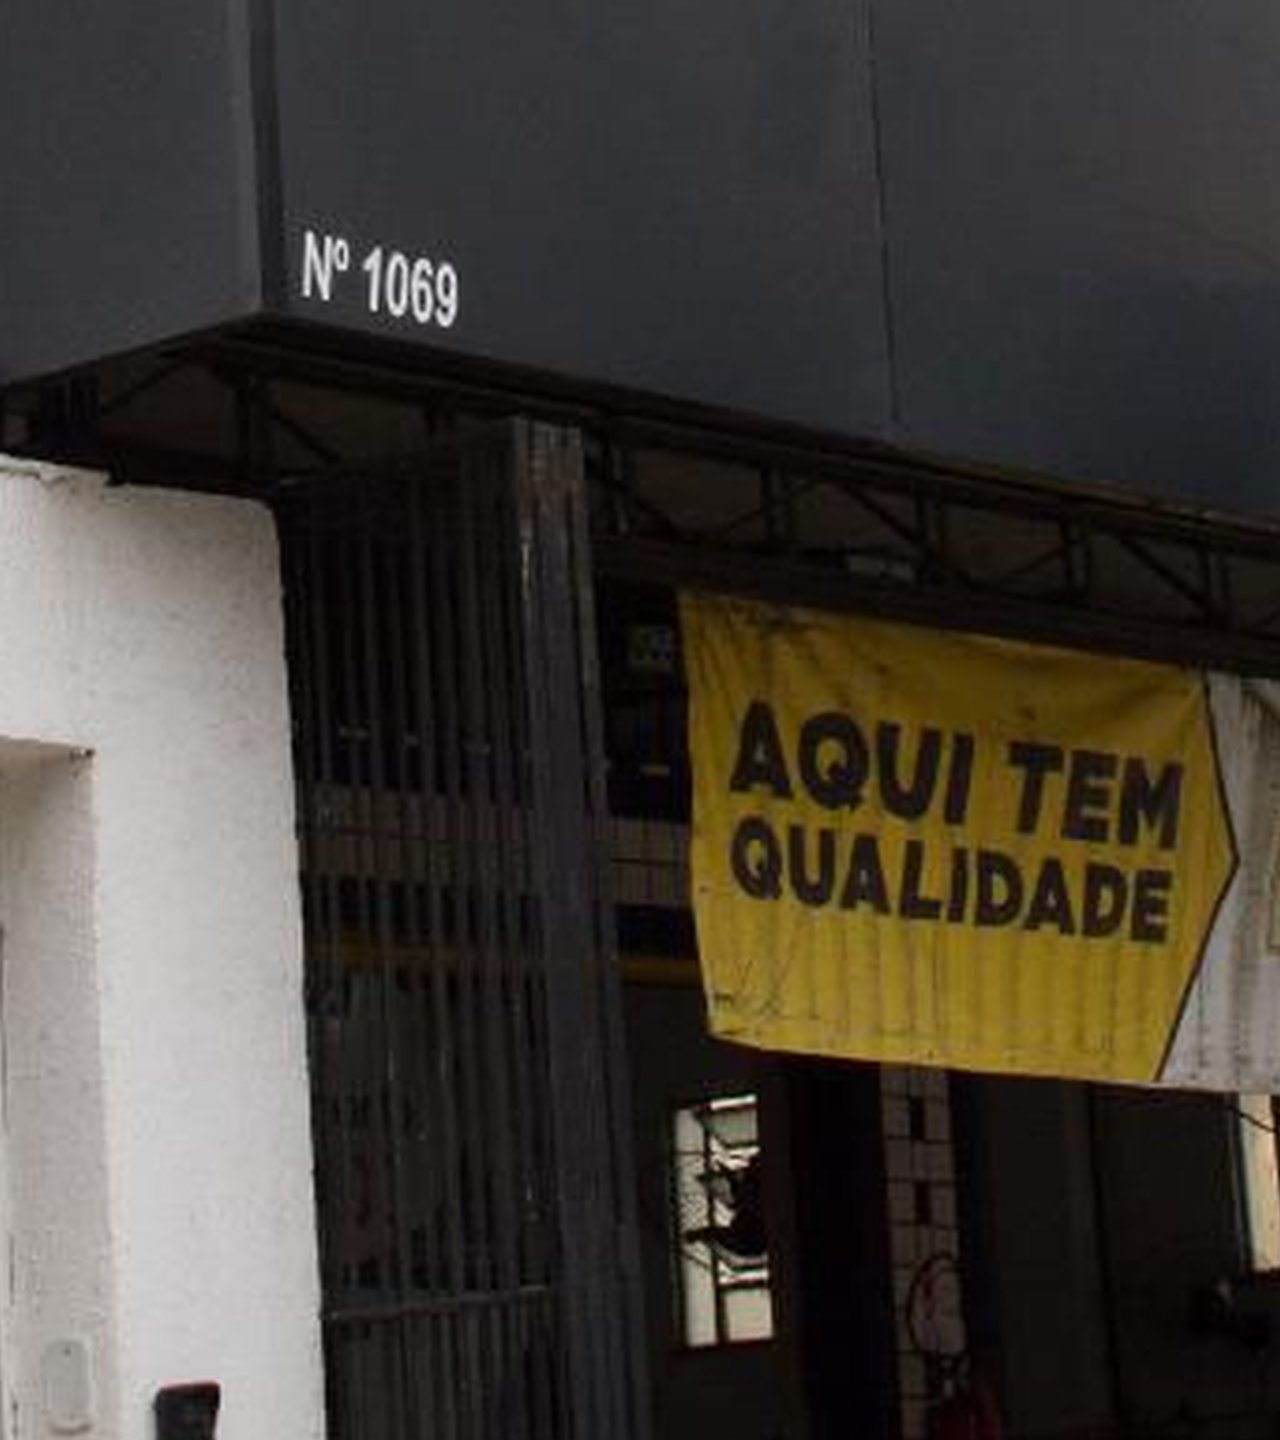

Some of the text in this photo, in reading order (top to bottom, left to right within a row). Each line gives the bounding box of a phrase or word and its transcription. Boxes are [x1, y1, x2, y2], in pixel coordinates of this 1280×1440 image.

[363, 246, 459, 328] 1069
[729, 697, 1185, 851] AQUI TEM
[729, 813, 1175, 944] QUALIDADE
